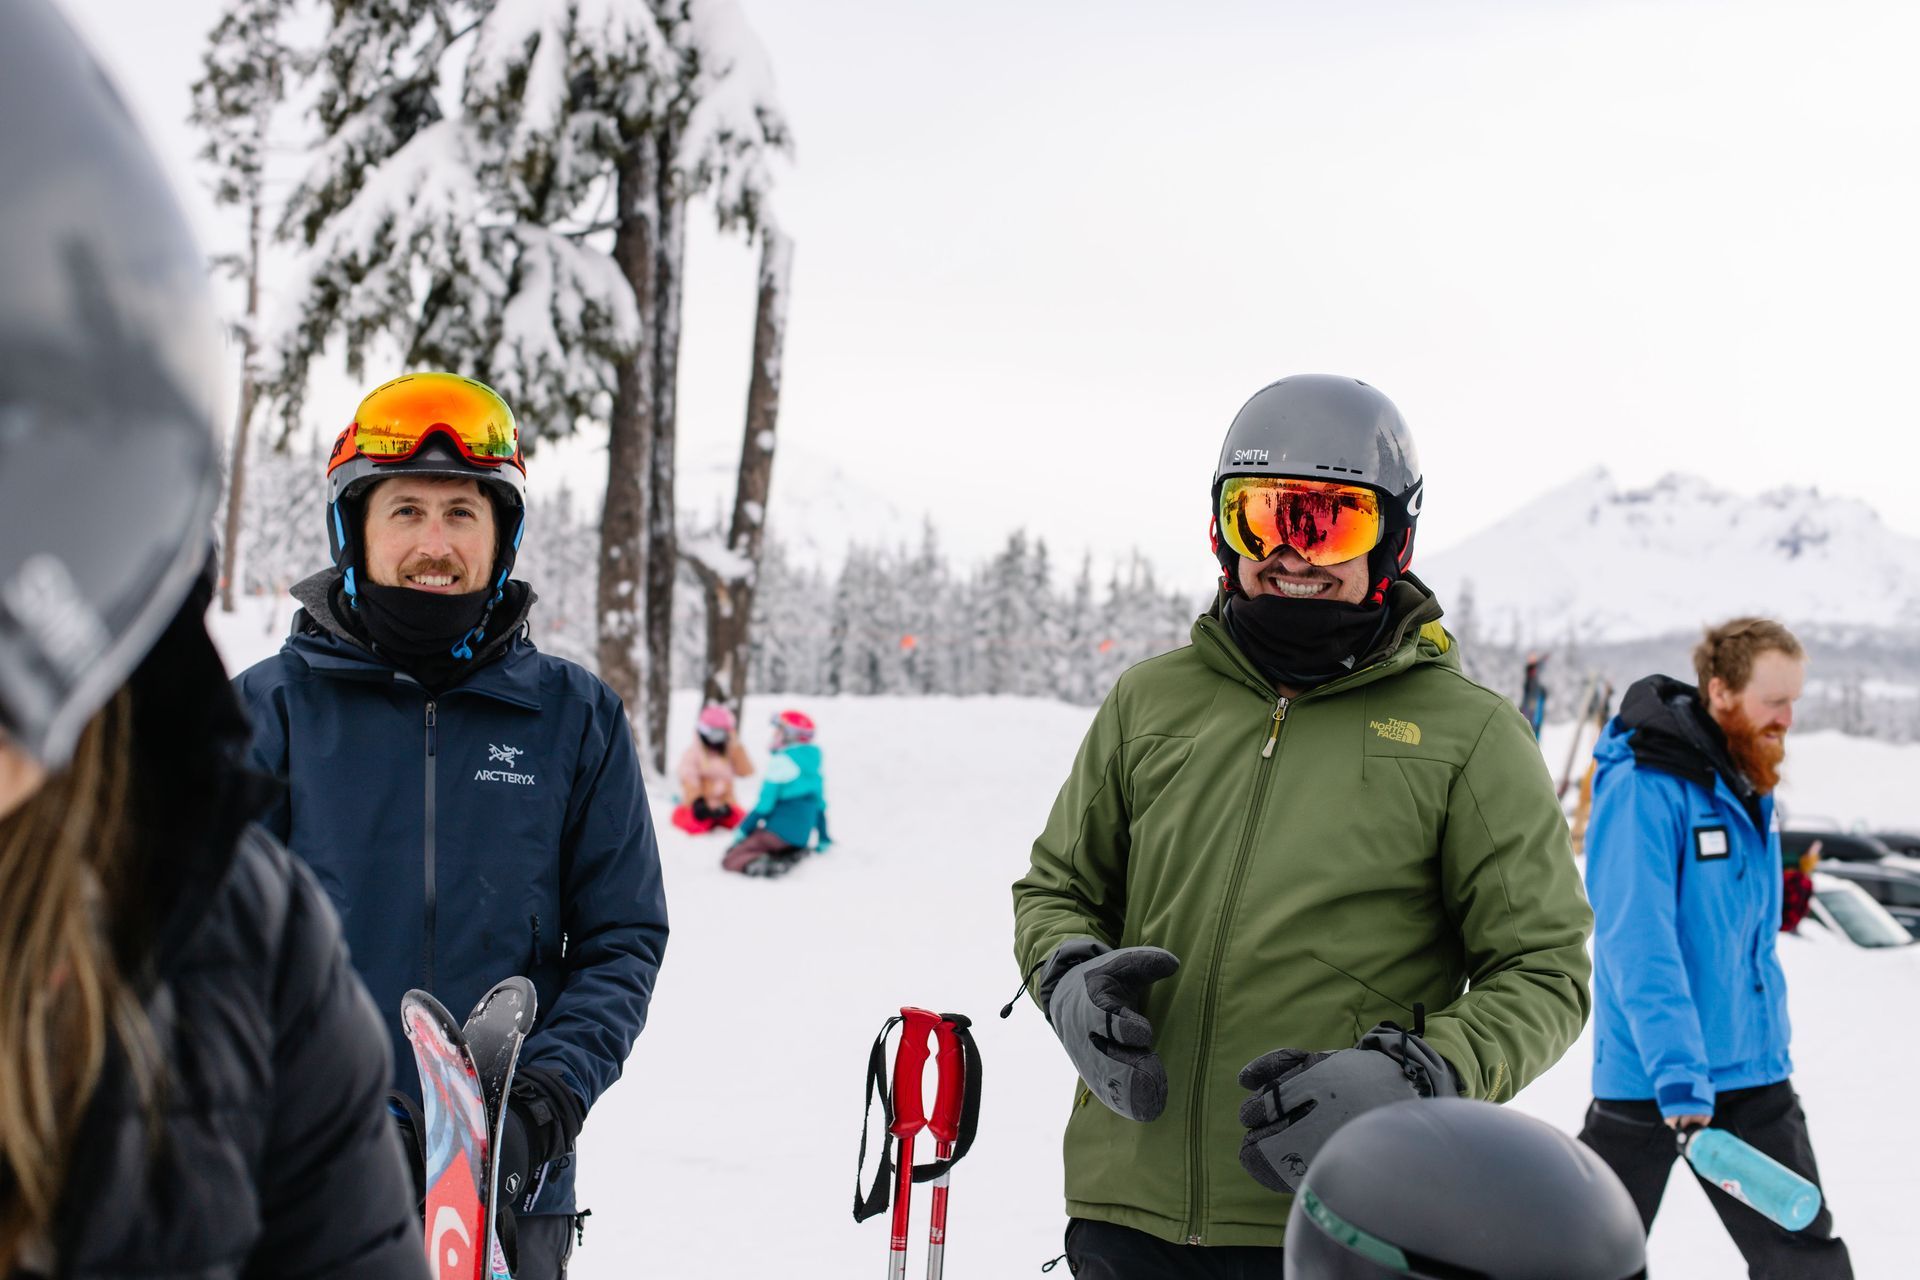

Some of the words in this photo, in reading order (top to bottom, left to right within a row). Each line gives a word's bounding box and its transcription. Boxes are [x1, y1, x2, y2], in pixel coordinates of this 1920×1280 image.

[1234, 449, 1269, 461] SMITH
[1369, 720, 1406, 735] NORTH
[1388, 717, 1407, 729] THE
[1377, 729, 1403, 742] FACE
